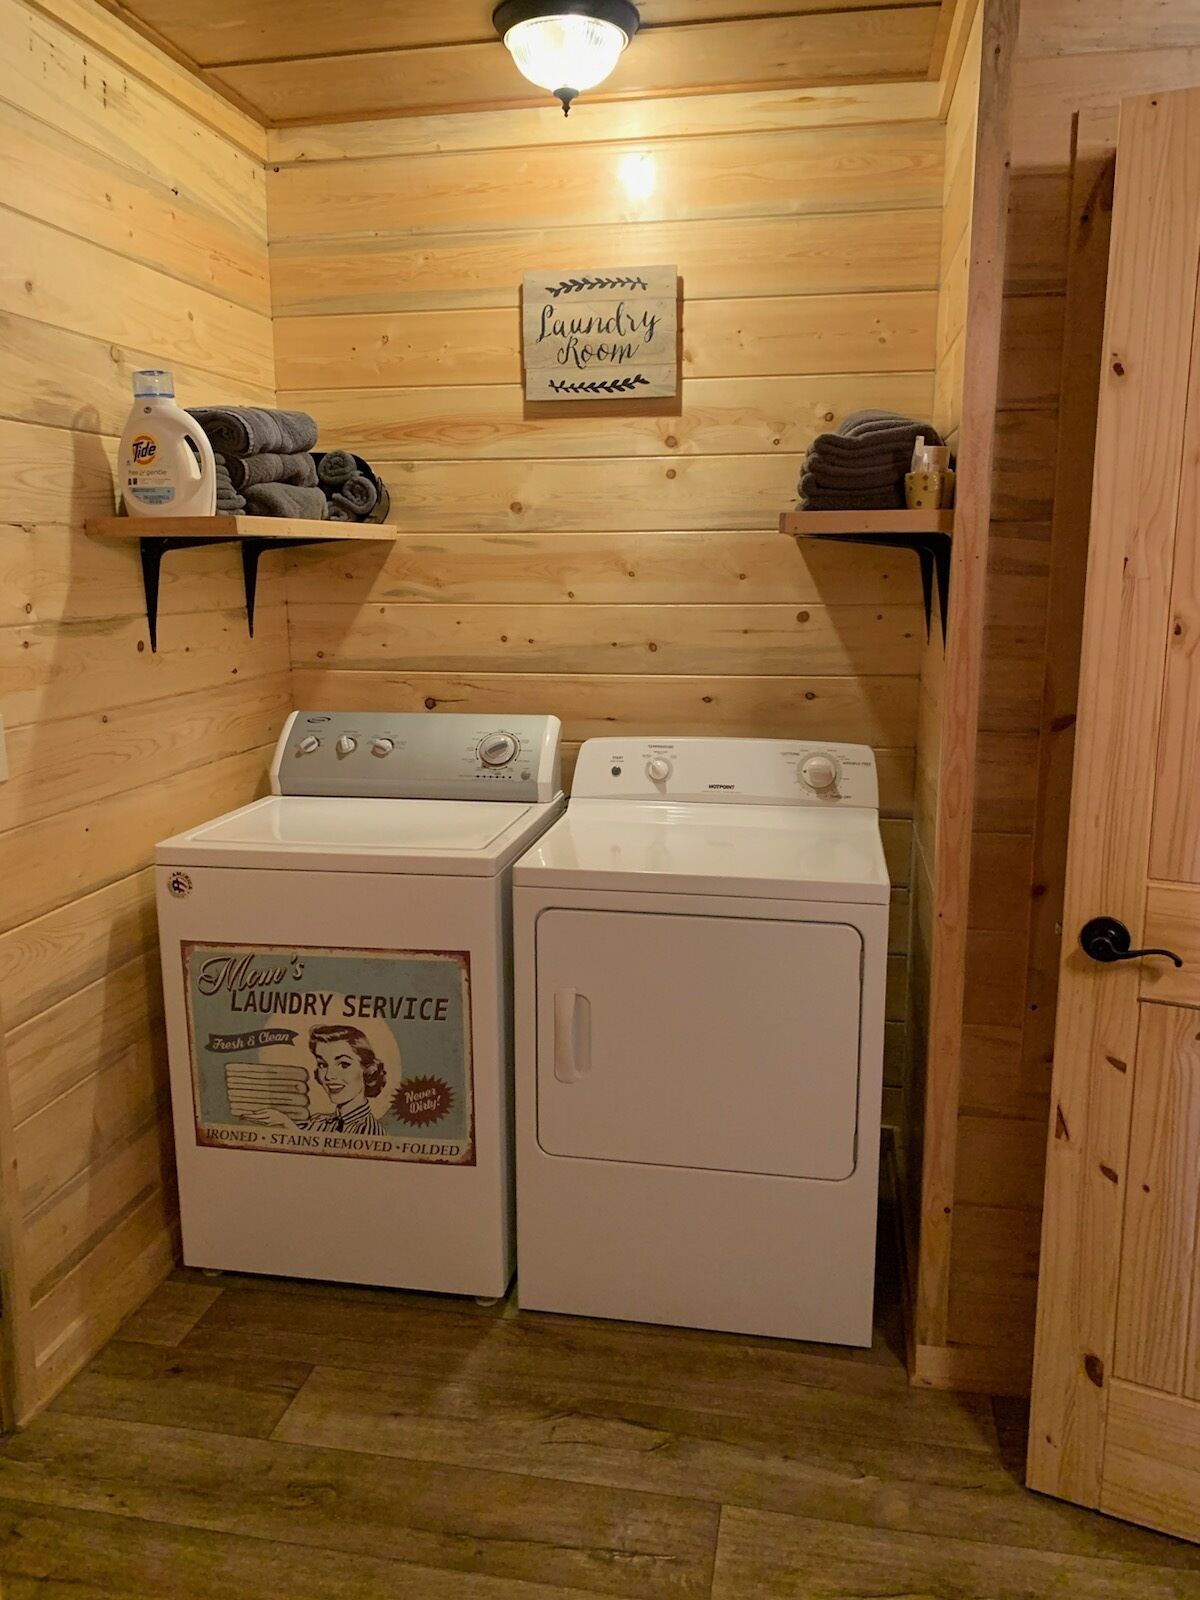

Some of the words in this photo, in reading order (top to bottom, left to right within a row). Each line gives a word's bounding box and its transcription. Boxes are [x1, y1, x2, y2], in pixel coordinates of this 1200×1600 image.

[536, 301, 662, 343] Laundry
[557, 335, 640, 370] Room
[132, 441, 157, 463] Tide
[197, 952, 304, 996] Mom's
[231, 989, 333, 1016] LAUNDRY
[342, 994, 449, 1021] SERVICE
[212, 1037, 244, 1050] Fresh
[247, 1035, 255, 1047] &
[258, 1031, 290, 1044] Clean
[404, 1087, 436, 1104] Never
[409, 1094, 441, 1114] Dirty!
[205, 1128, 258, 1143] IRONED
[270, 1133, 320, 1148] STAINS
[324, 1137, 392, 1152] REMOVED
[401, 1142, 460, 1157] FOLDED
